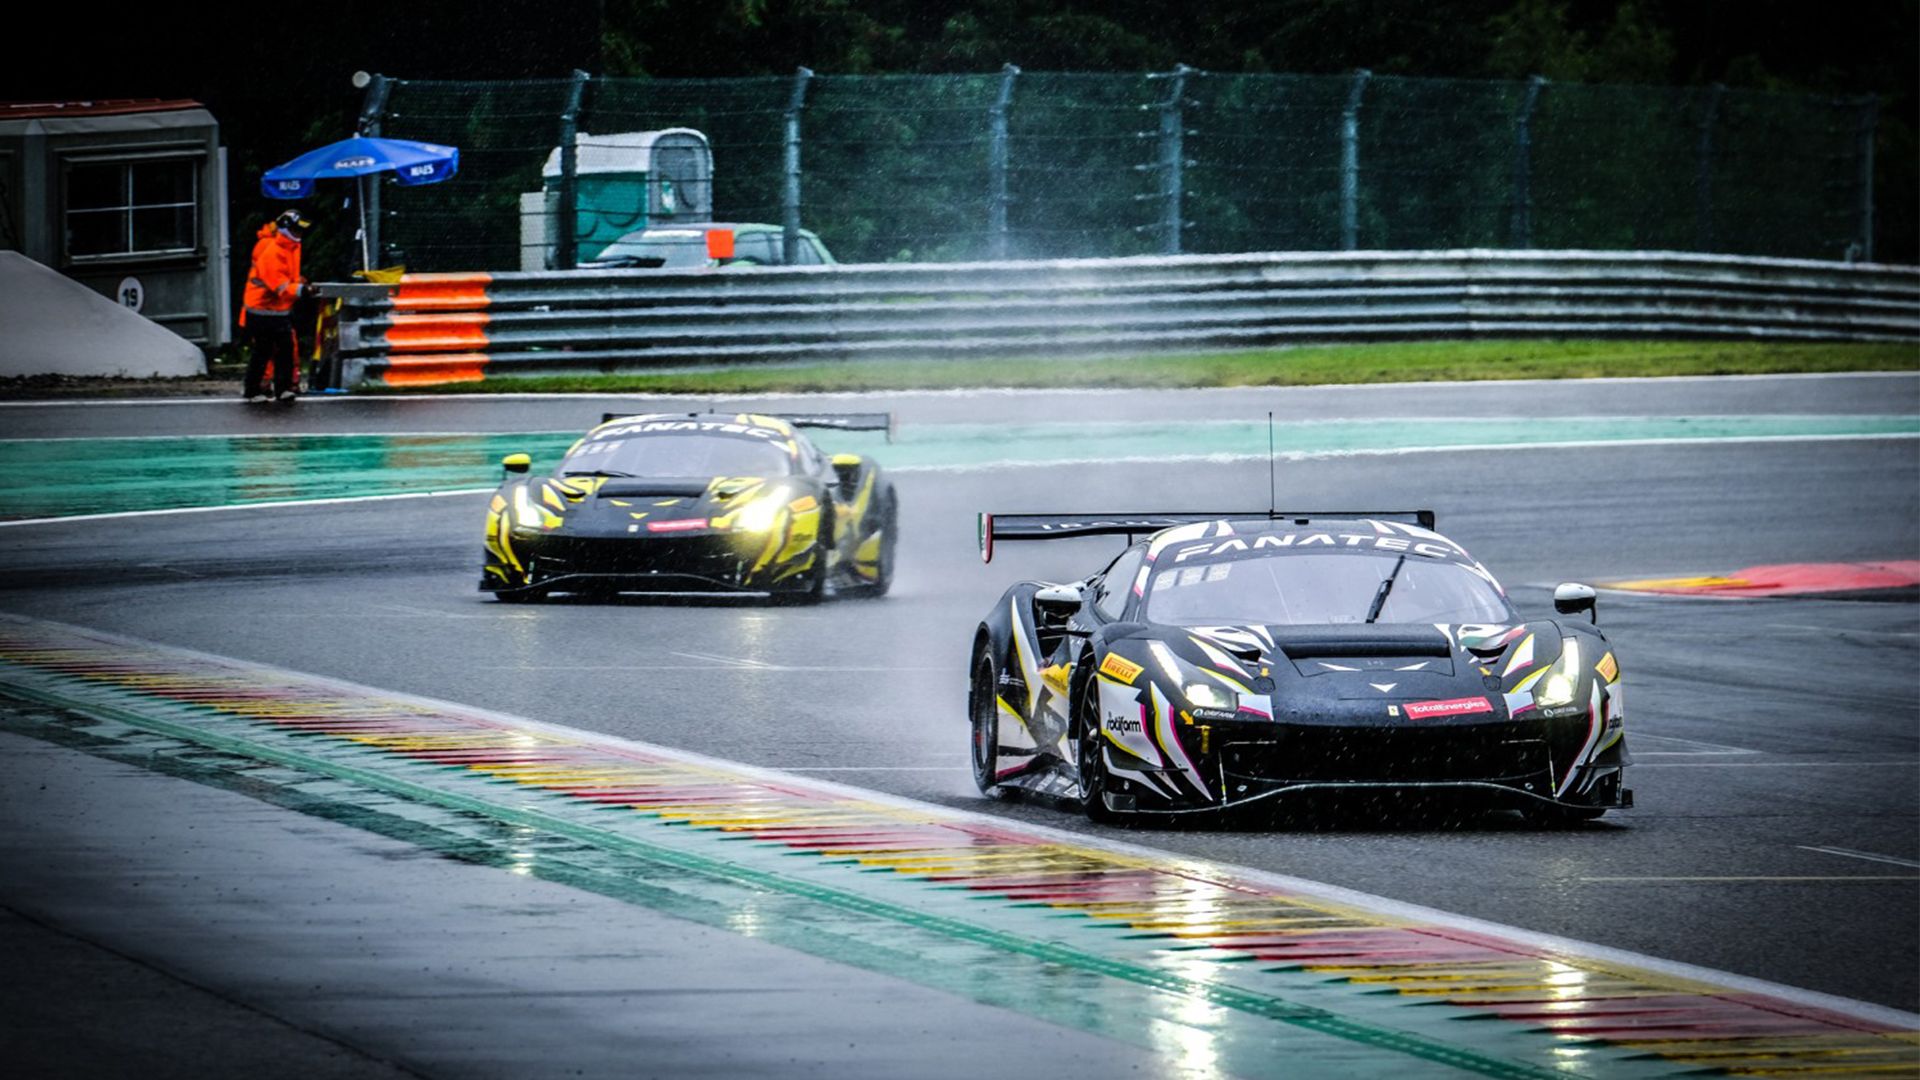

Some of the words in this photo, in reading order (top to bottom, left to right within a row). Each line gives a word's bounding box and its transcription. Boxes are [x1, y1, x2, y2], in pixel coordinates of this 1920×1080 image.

[122, 288, 138, 307] 19
[593, 421, 778, 441] FANATEC
[1174, 533, 1451, 563] FANATEC
[1103, 655, 1138, 680] PIRELLI
[1411, 700, 1487, 714] TotalEnergies
[1106, 711, 1142, 736] rotiform
